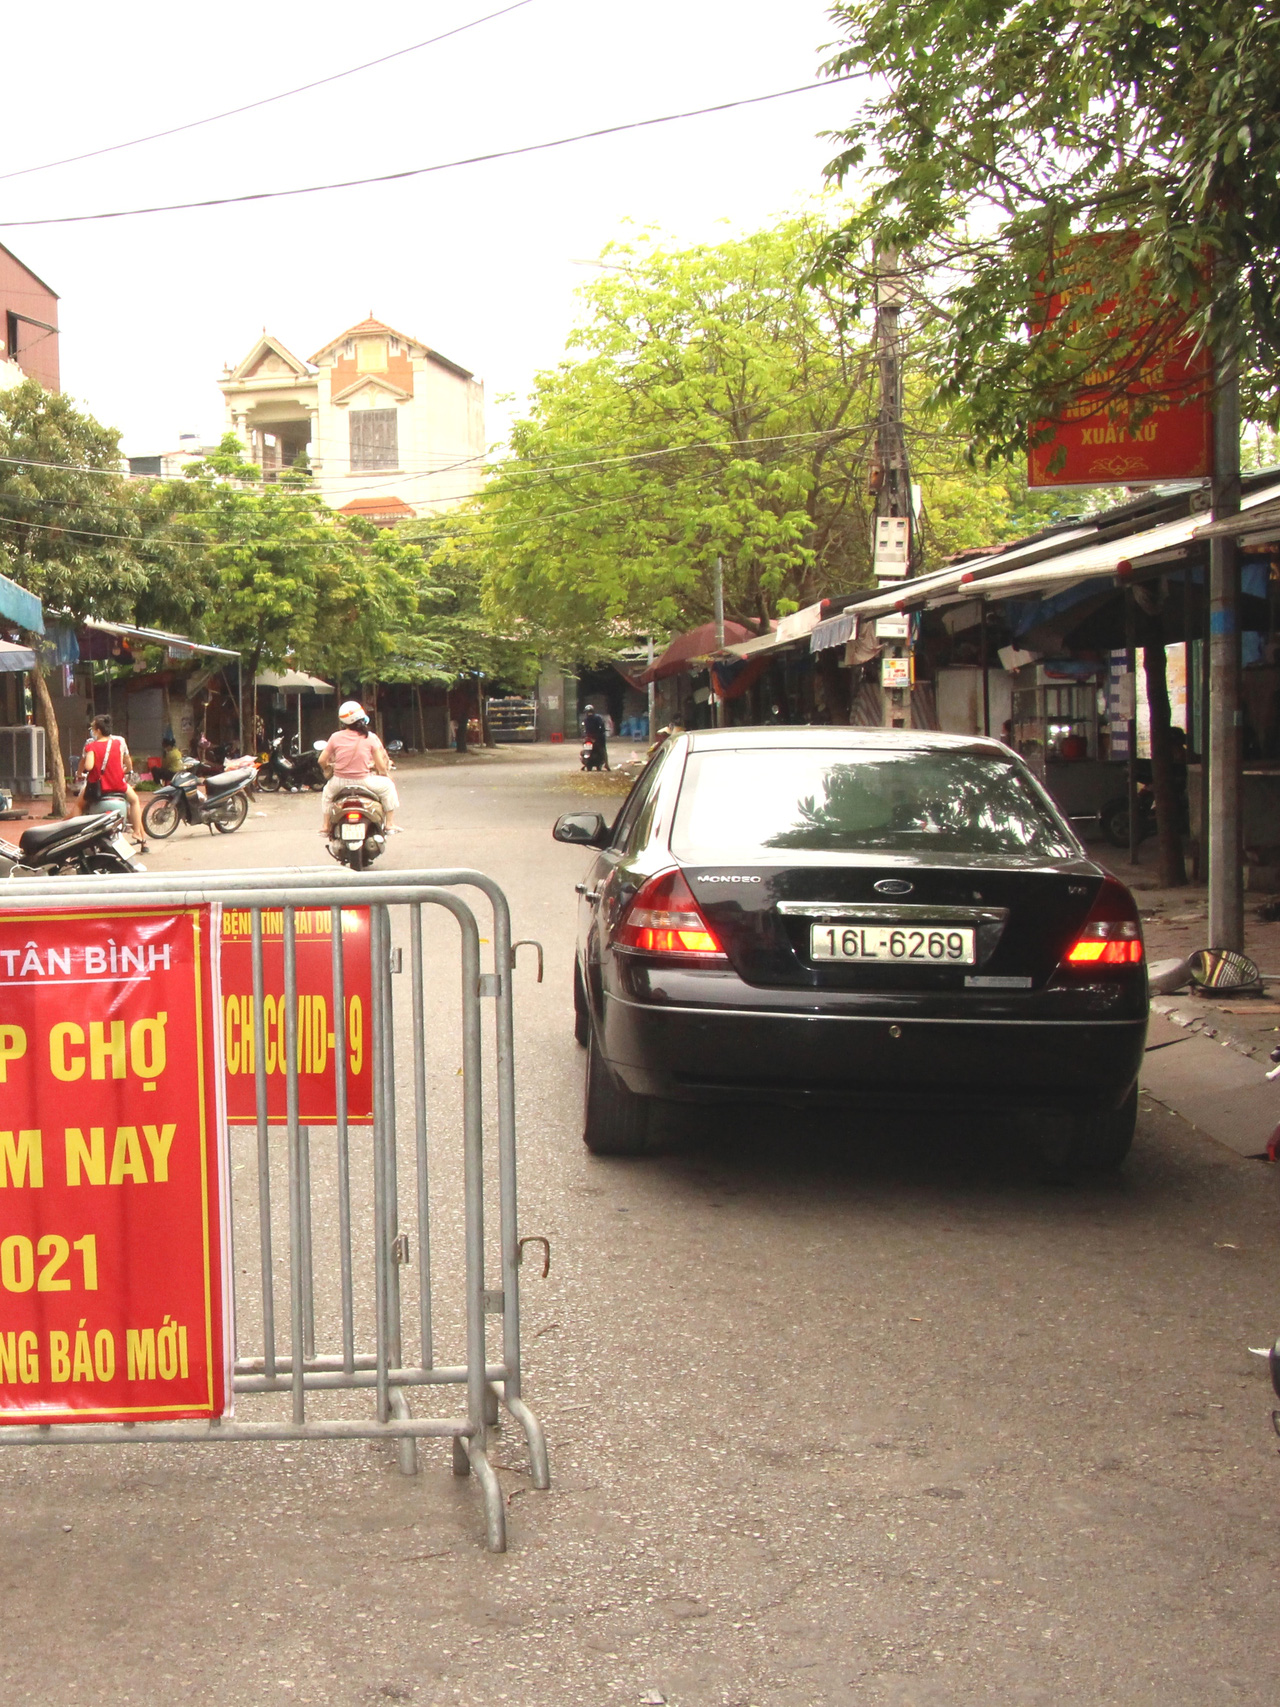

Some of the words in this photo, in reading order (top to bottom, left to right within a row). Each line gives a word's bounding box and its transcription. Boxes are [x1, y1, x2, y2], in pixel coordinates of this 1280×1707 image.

[697, 875, 761, 883] MONDEO
[0, 941, 72, 977] TÂN
[88, 940, 172, 975] BÌNH
[826, 928, 963, 959] 16L-6269
[49, 1012, 168, 1092] CHỢ
[65, 1123, 177, 1187] NAY
[50, 1318, 115, 1383] BÁO
[126, 1314, 189, 1381] MỚI
